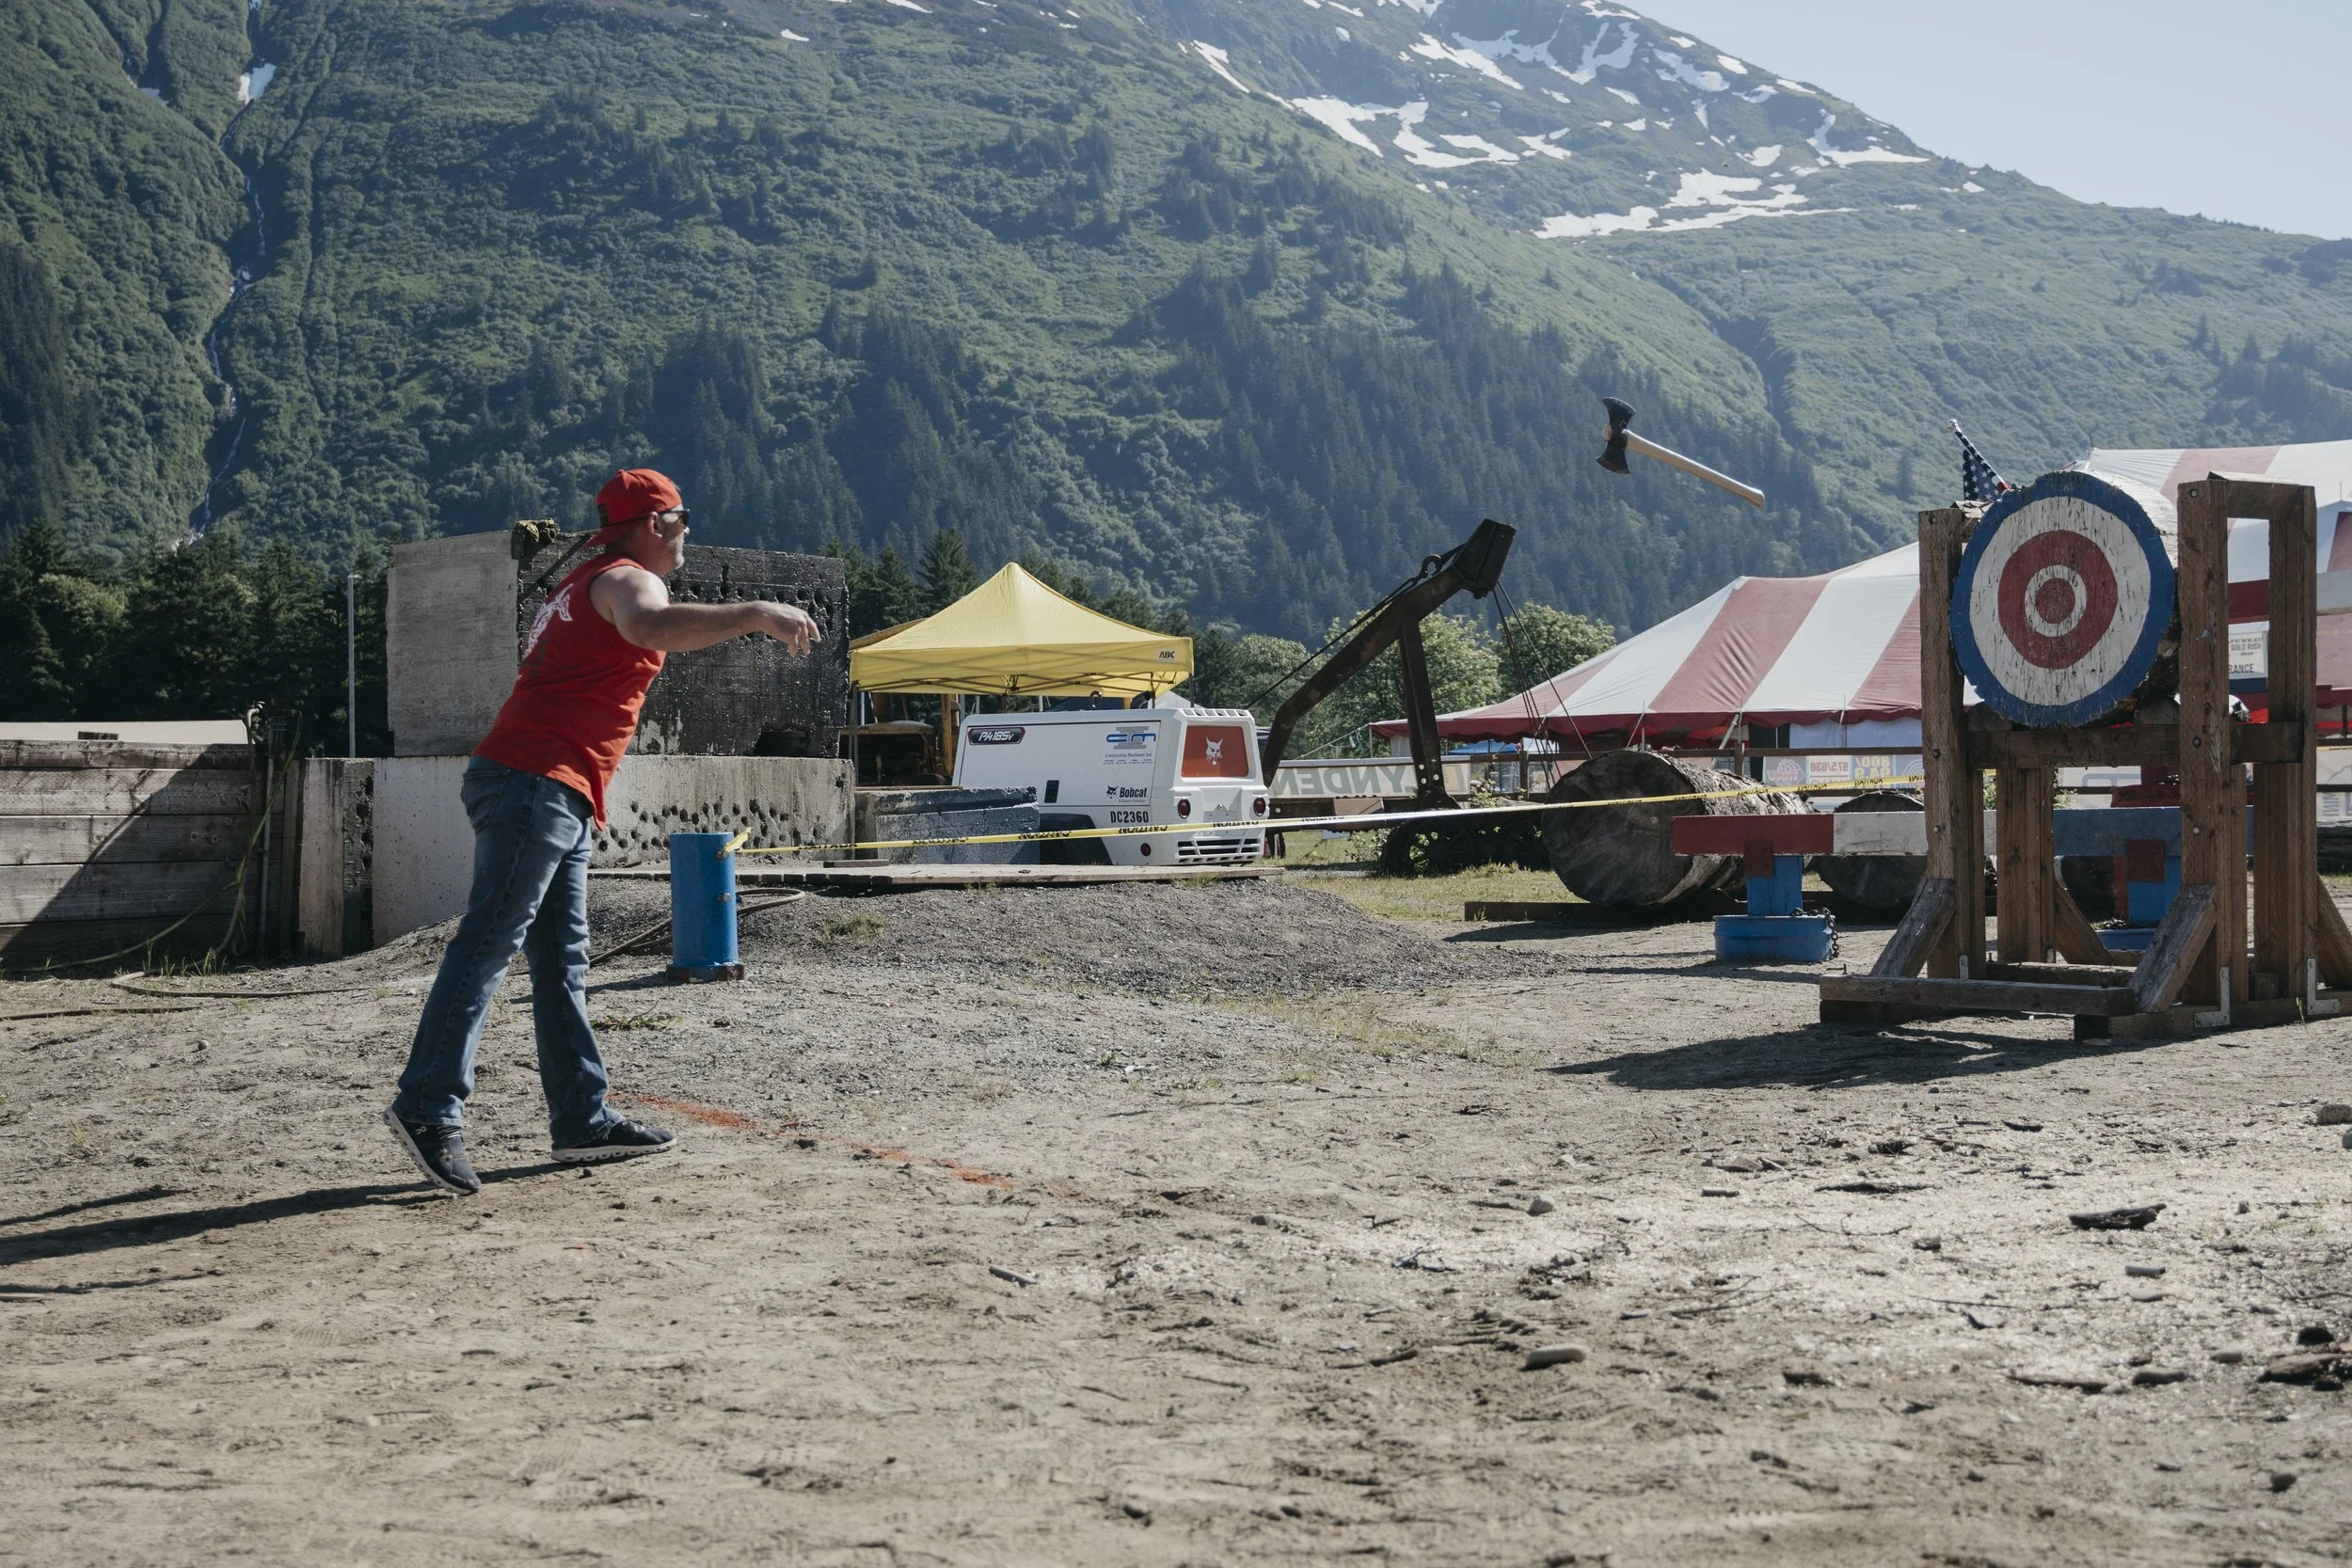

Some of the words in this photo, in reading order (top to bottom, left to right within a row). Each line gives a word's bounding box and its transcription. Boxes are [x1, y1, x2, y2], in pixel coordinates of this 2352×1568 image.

[1158, 650, 1175, 658] ABC
[2228, 663, 2254, 673] RANCE
[1119, 786, 1148, 799] Bobcat
[1110, 810, 1150, 823] DC2360
